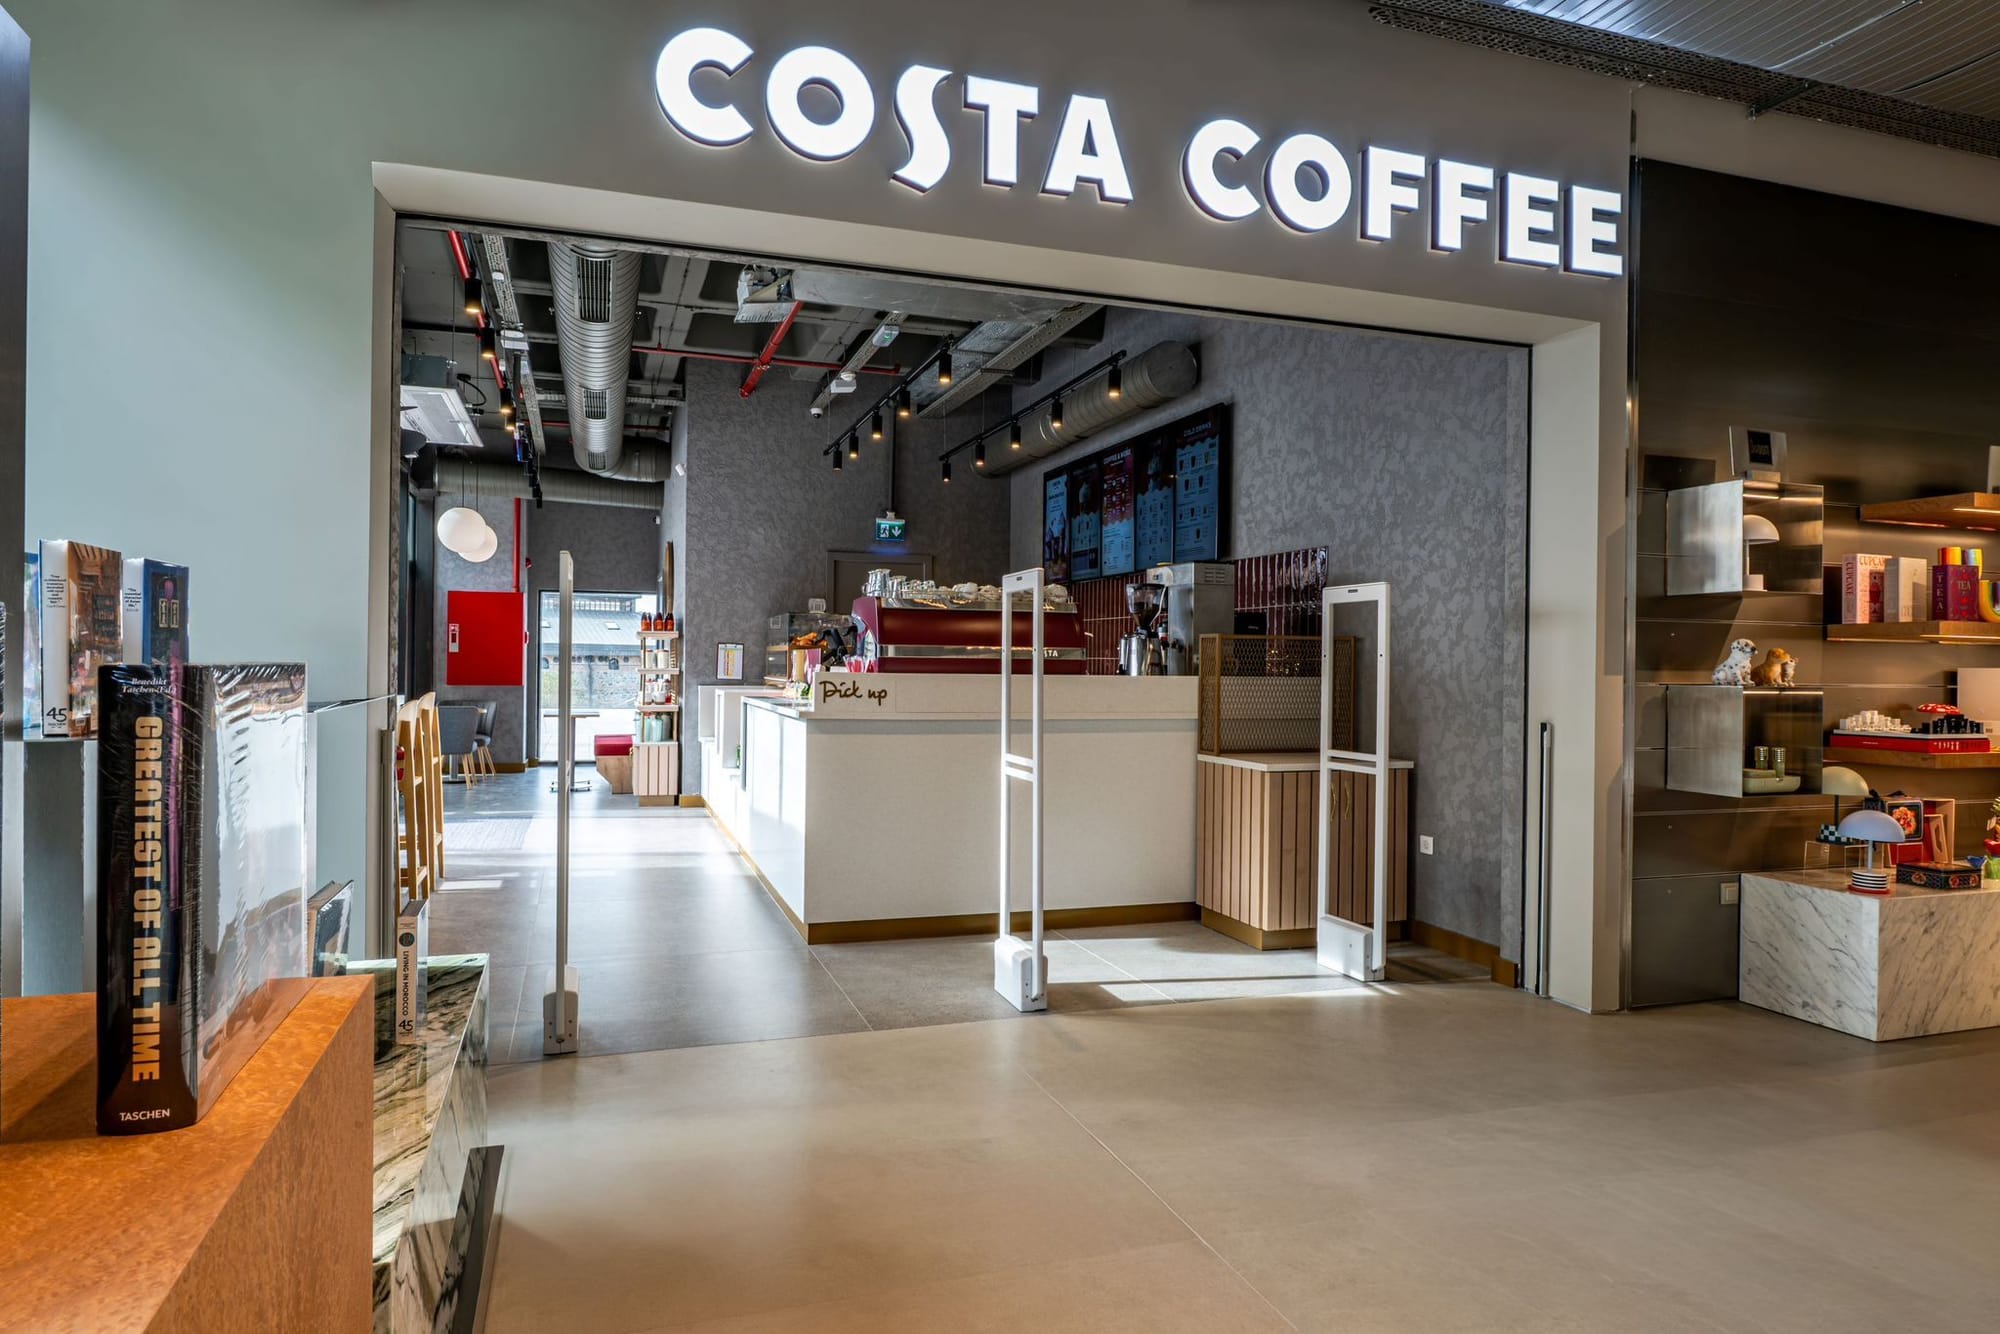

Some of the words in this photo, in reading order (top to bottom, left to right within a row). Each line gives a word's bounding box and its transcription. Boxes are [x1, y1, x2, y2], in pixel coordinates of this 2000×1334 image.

[655, 27, 1134, 206] COSTA
[1182, 119, 1623, 278] COFFEE
[1957, 580, 1971, 591] TEA
[1044, 649, 1058, 658] STA
[131, 677, 167, 685] Benedikt
[819, 680, 863, 703] Pick
[868, 689, 888, 706] up
[46, 706, 67, 723] 45
[134, 716, 163, 882] GREATEST
[133, 889, 162, 929] OF
[133, 937, 162, 996] ALL
[402, 951, 410, 972] LIVING
[402, 973, 410, 981] IN
[402, 982, 410, 1016] MOROCCO
[398, 1019, 414, 1032] 45
[132, 1002, 161, 1082] TIME
[119, 1107, 171, 1121] TASCHEN
